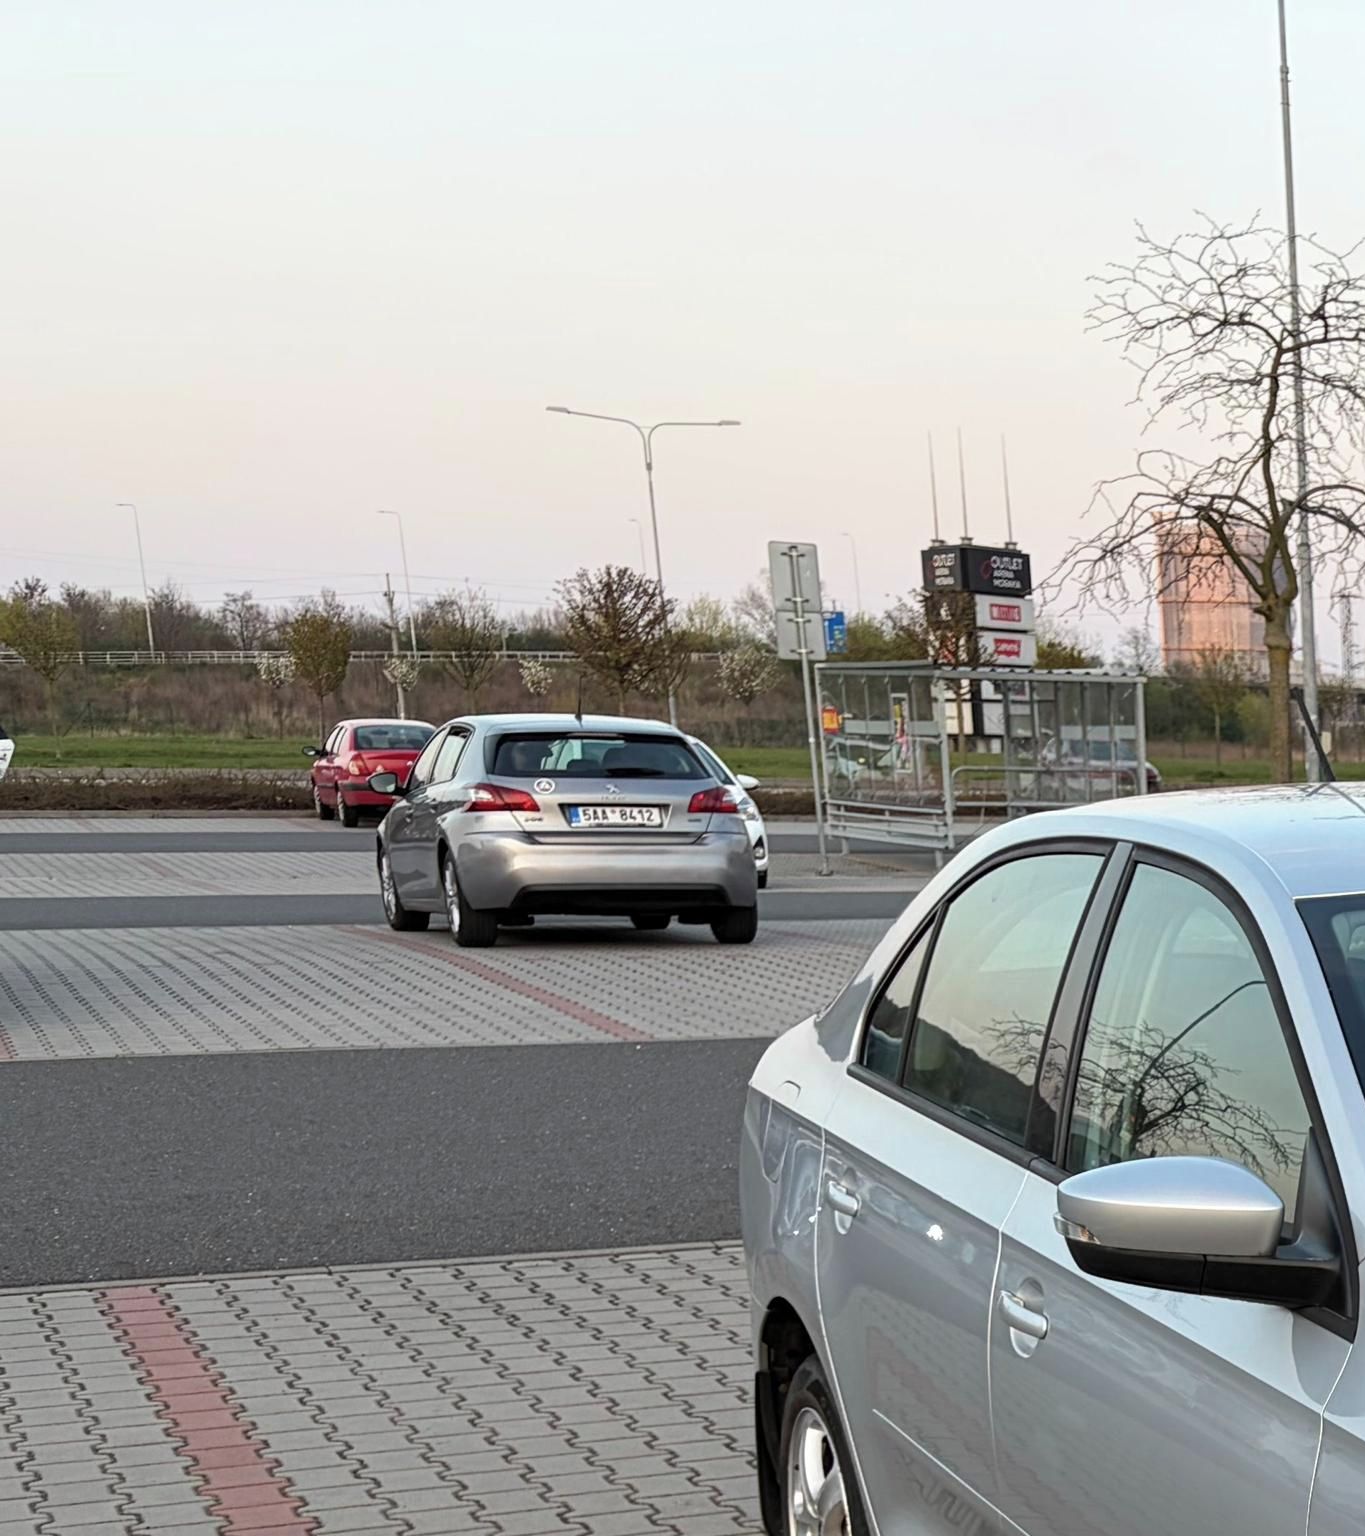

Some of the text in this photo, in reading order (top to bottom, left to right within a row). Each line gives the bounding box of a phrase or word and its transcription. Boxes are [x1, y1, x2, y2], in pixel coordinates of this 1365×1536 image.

[991, 556, 1022, 570] OUTLET
[582, 808, 655, 823] 5AA 8412
